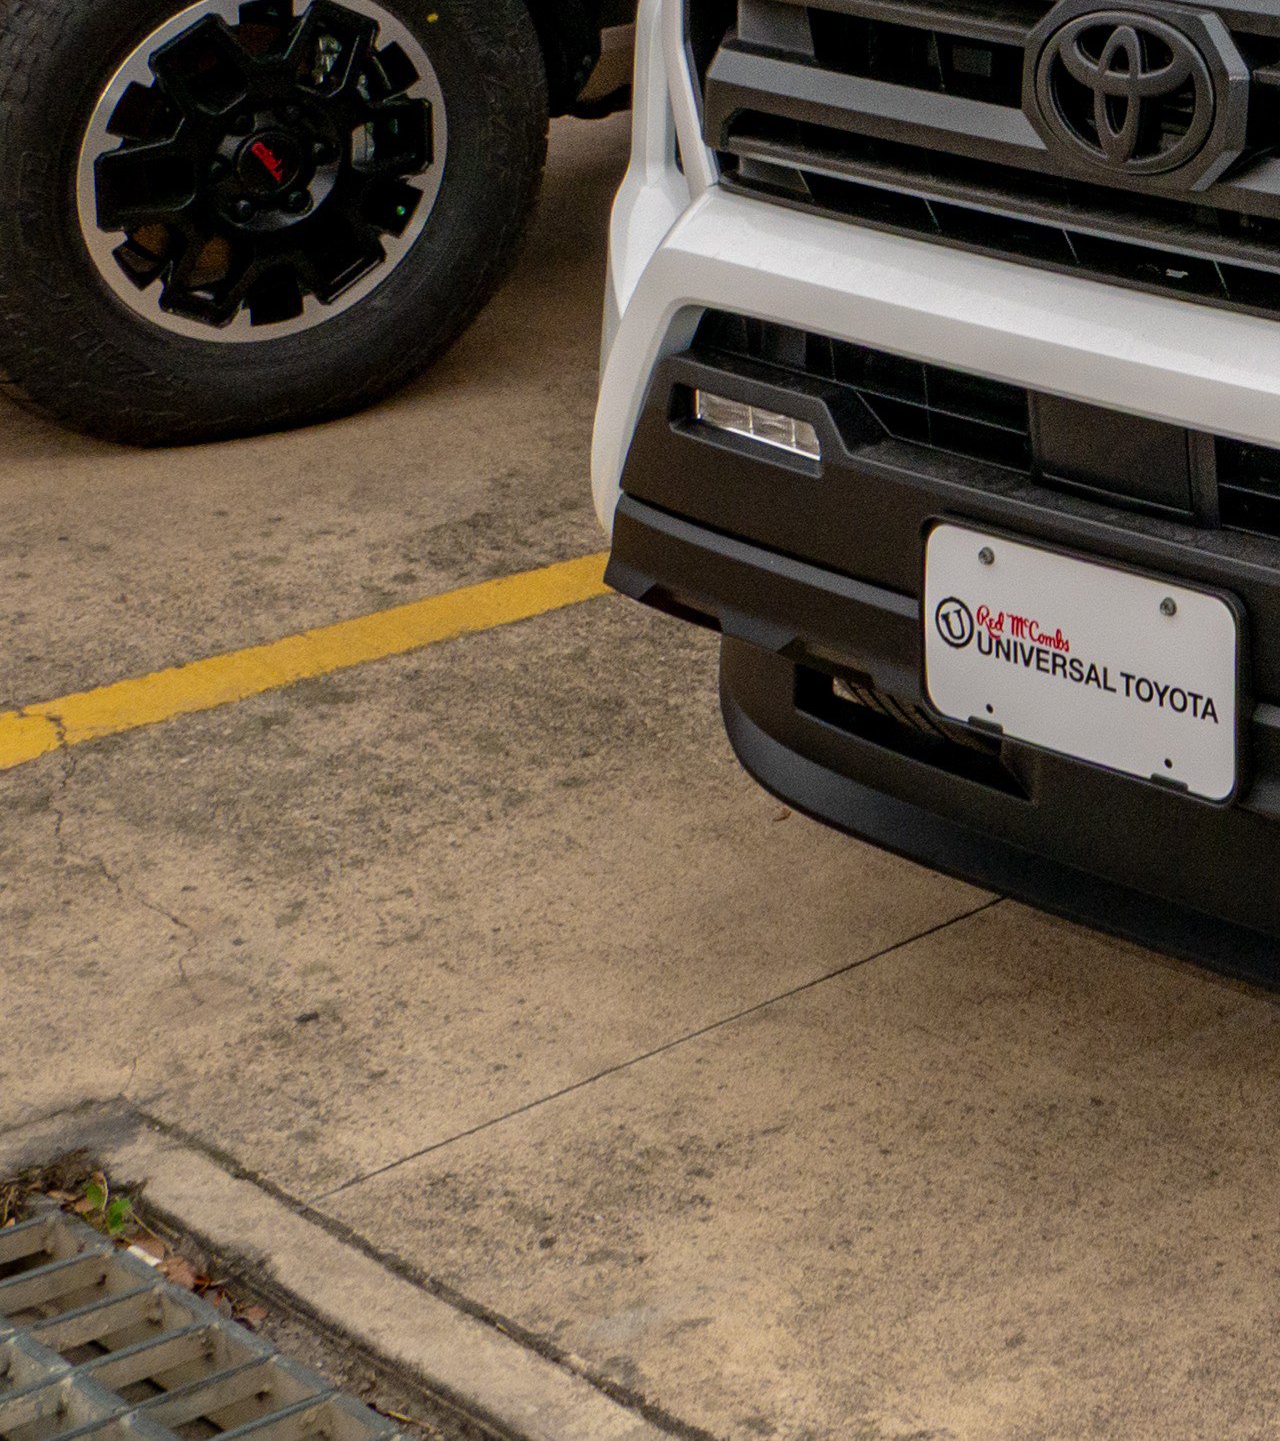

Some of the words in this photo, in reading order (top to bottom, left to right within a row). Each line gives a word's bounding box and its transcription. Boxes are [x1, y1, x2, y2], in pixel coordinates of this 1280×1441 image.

[976, 604, 1004, 640] Red
[1007, 613, 1070, 653] McCombs
[977, 630, 1117, 693] UNIVERSAL
[1120, 671, 1219, 724] TOYOTA
